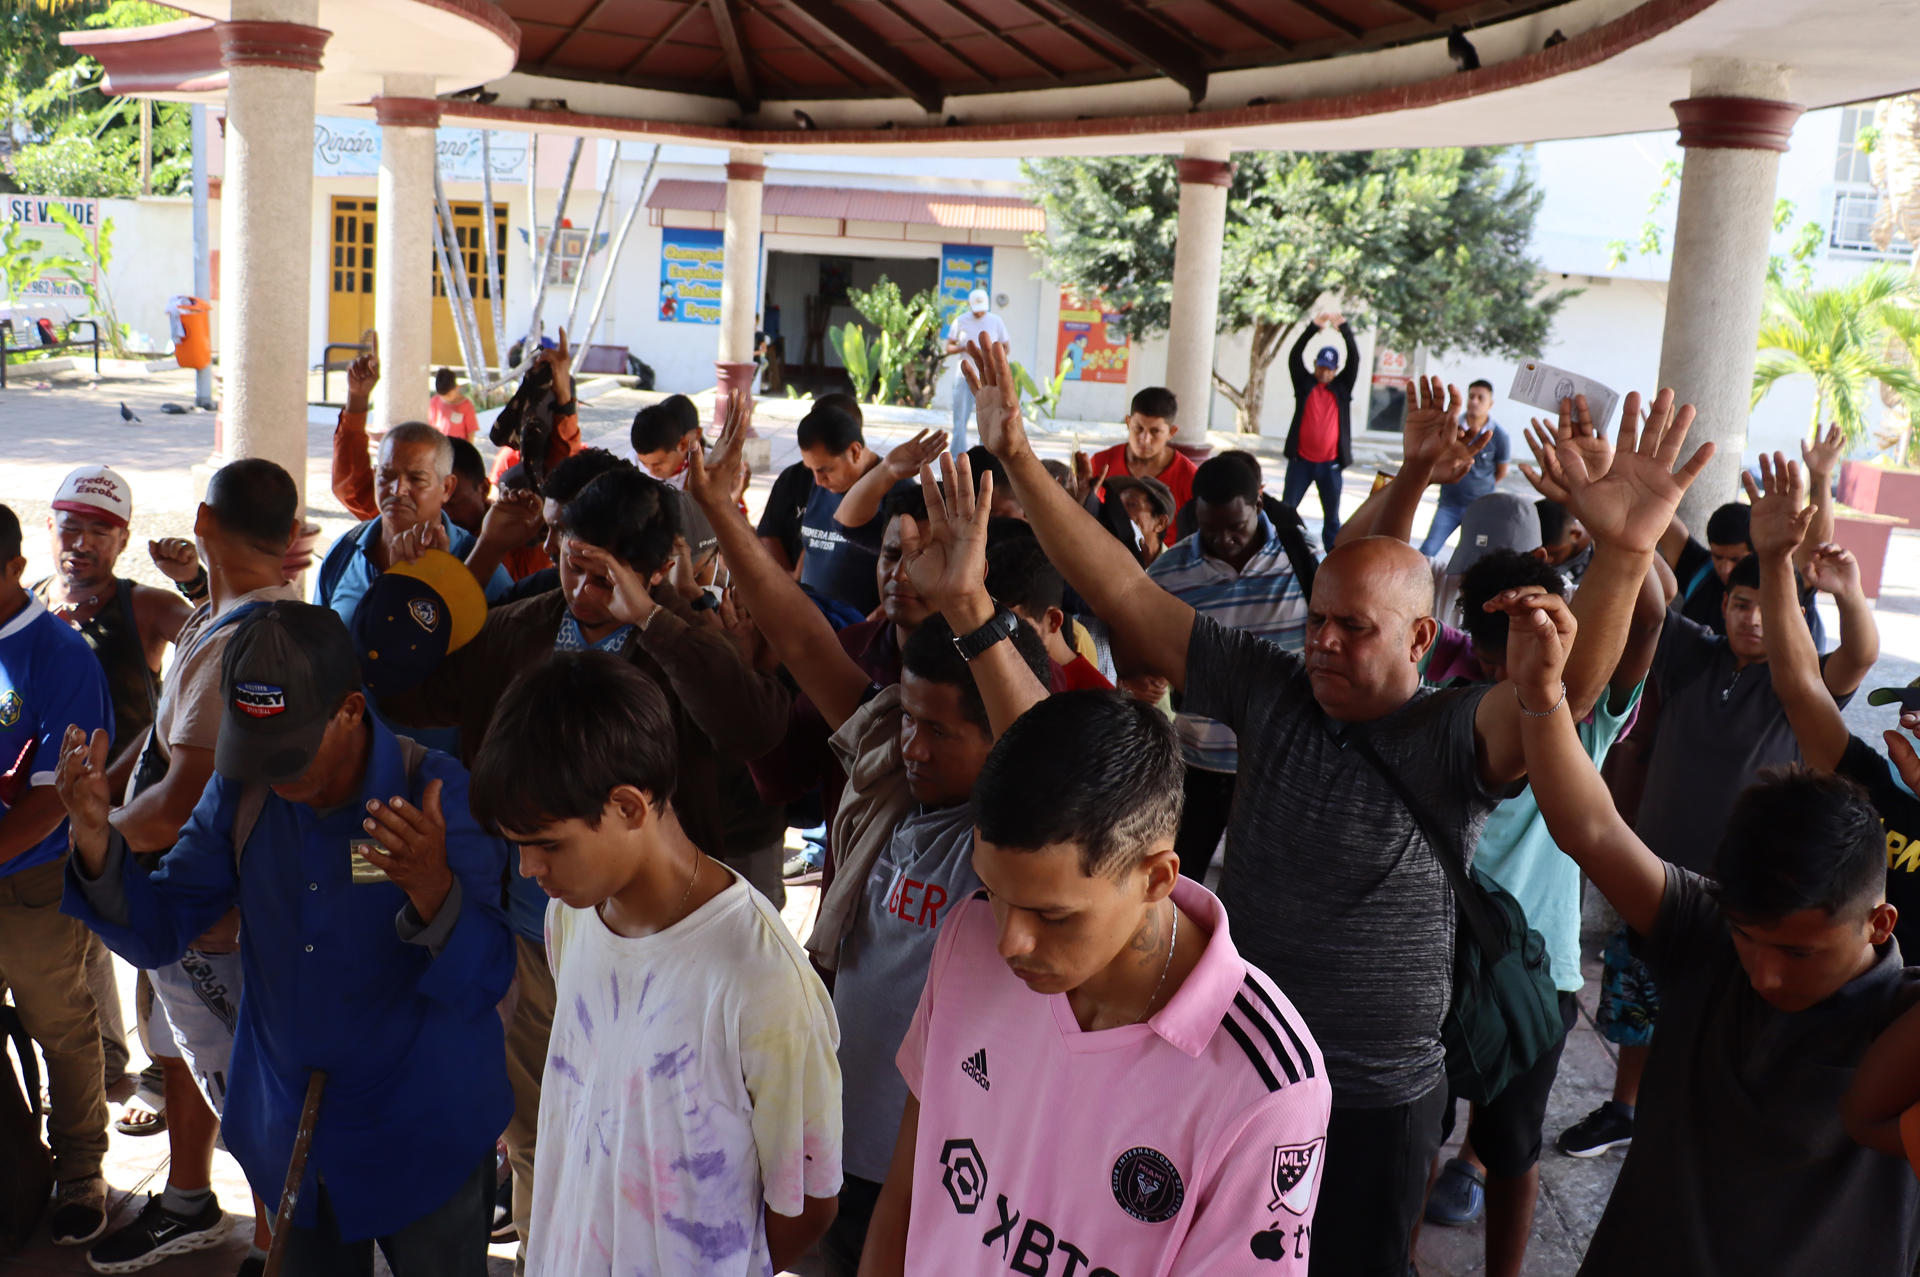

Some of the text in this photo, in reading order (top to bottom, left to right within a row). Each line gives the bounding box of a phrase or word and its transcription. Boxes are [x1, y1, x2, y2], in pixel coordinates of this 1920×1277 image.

[12, 200, 94, 225] SE VDE
[74, 477, 118, 490] Freddy
[76, 485, 122, 503] Escobar
[962, 1061, 990, 1091] adidas
[1280, 1150, 1310, 1167] MLS
[1138, 1163, 1165, 1182] MIAMI
